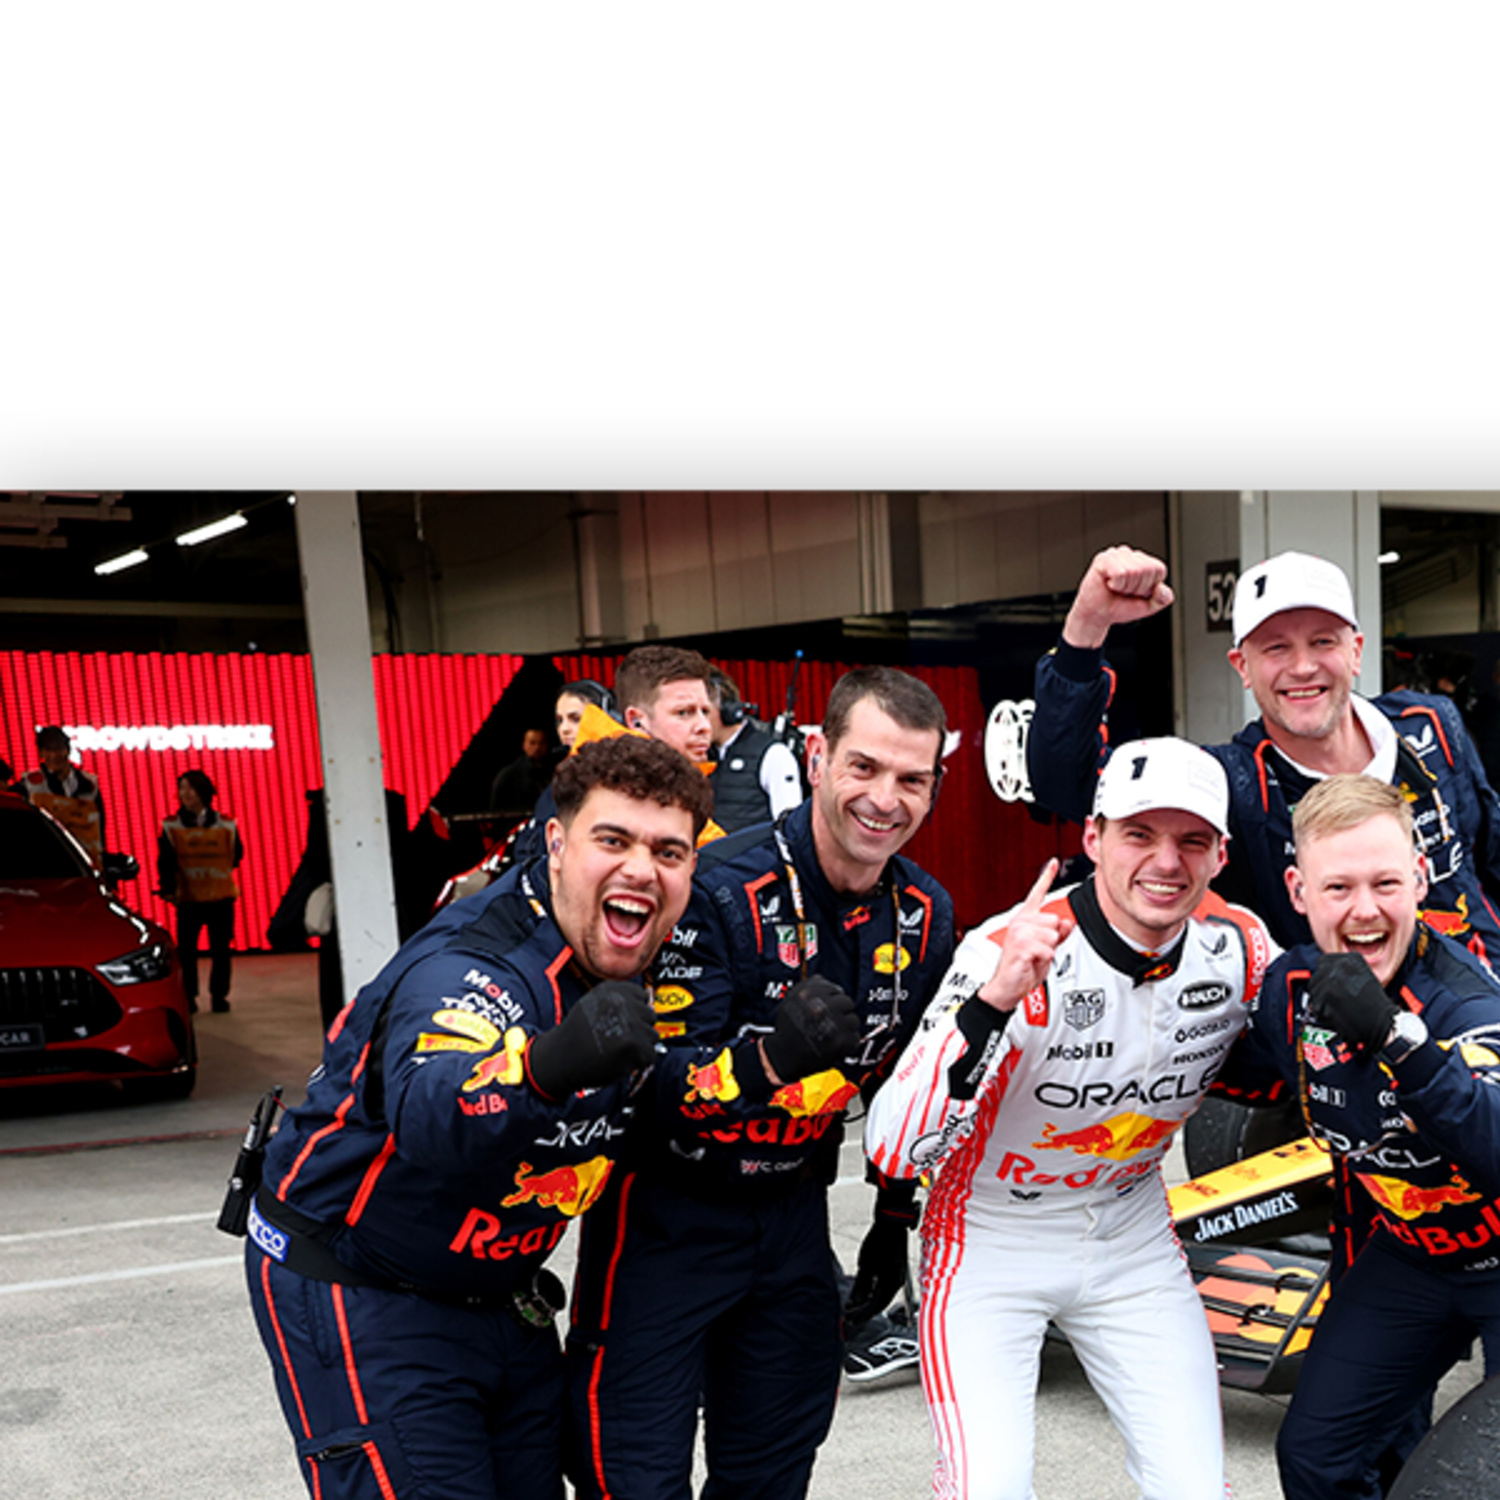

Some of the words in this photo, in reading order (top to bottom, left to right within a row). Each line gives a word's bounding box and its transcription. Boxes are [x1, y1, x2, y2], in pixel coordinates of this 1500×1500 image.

[1208, 573, 1236, 622] 52
[1254, 575, 1268, 599] 1
[66, 725, 274, 750] ROWDSTRIKE
[1130, 756, 1148, 780] 1
[463, 969, 524, 1023] Mobil
[1047, 1042, 1093, 1061] Mobil
[1034, 1062, 1219, 1109] ORACLE
[1195, 1213, 1236, 1242] JACK
